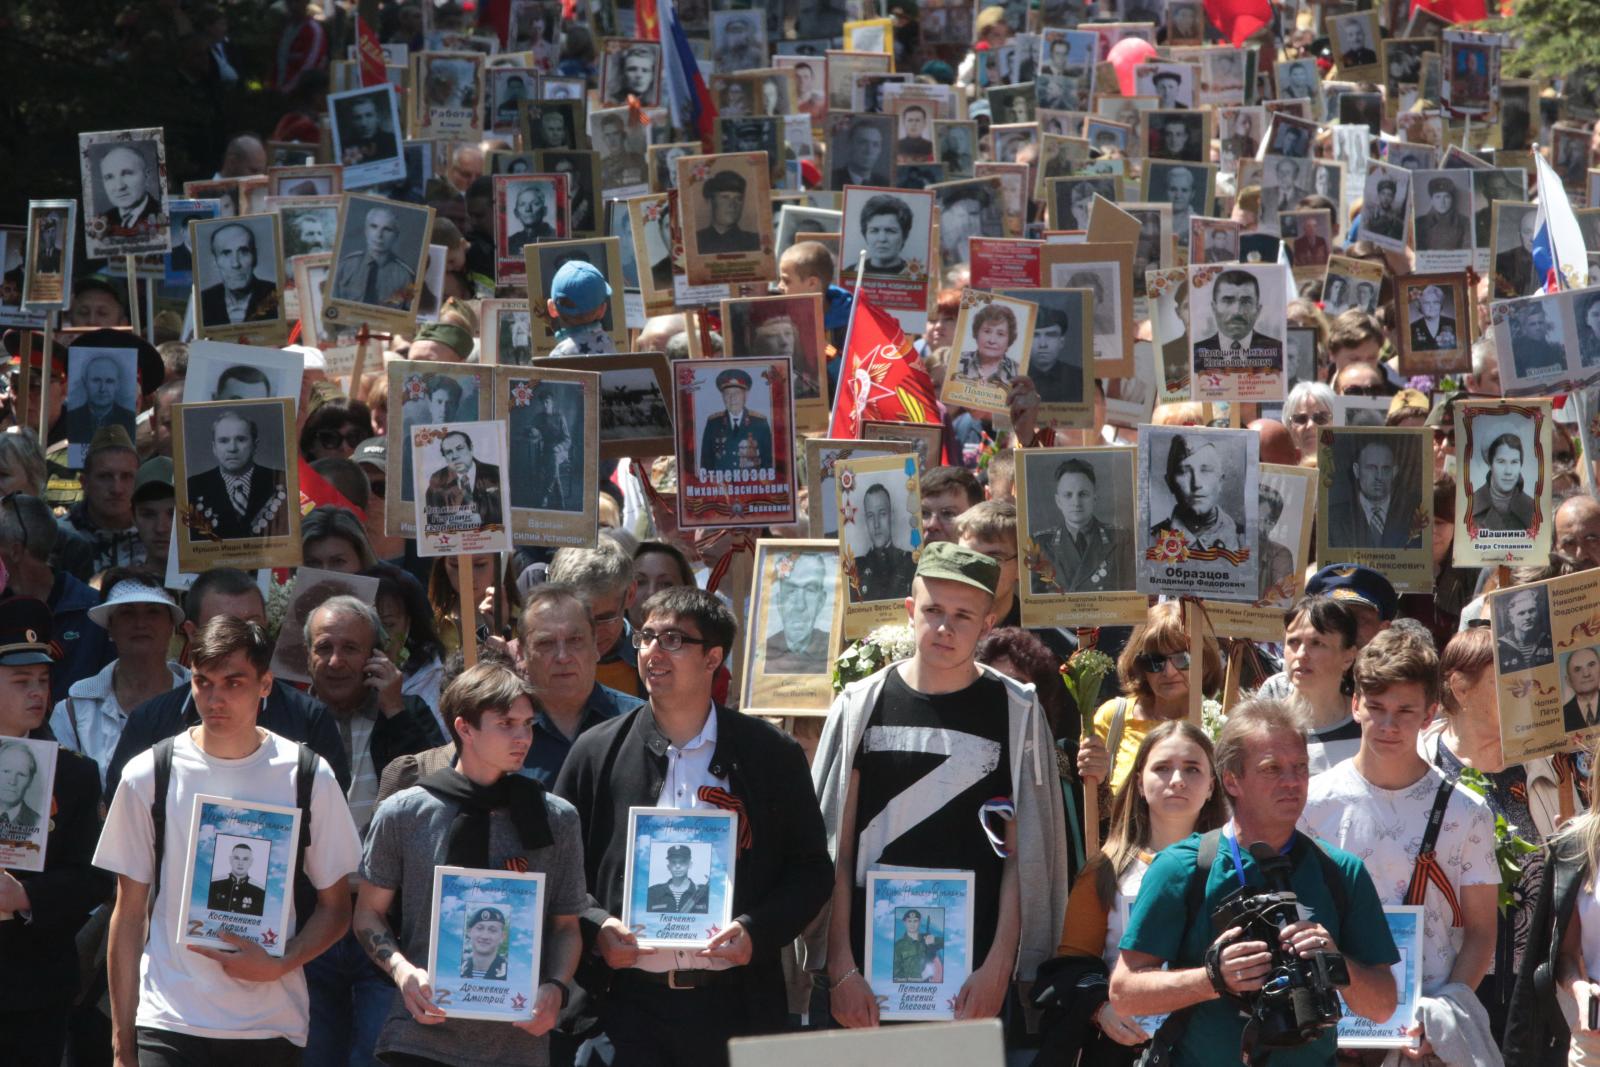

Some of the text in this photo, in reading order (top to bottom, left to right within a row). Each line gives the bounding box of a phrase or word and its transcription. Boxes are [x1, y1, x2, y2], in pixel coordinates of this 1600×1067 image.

[699, 467, 776, 483] Стрекозов
[686, 483, 790, 496] Михаил Васильевич
[1479, 529, 1526, 539] Шашнина
[1165, 567, 1231, 581] Образцов
[1149, 576, 1246, 588] Владимир Федорович
[207, 911, 262, 926] Костенников
[659, 913, 696, 923] Ткаченко
[220, 923, 248, 933] Кирилл
[656, 931, 698, 940] Сергеевич
[459, 983, 510, 994] Дрожевкин
[898, 984, 938, 994] Петелько
[462, 993, 505, 1004] Дмитрий
[901, 993, 934, 1001] Евгений
[899, 1001, 936, 1010] Олегович
[1338, 1027, 1393, 1037] Леонидович
